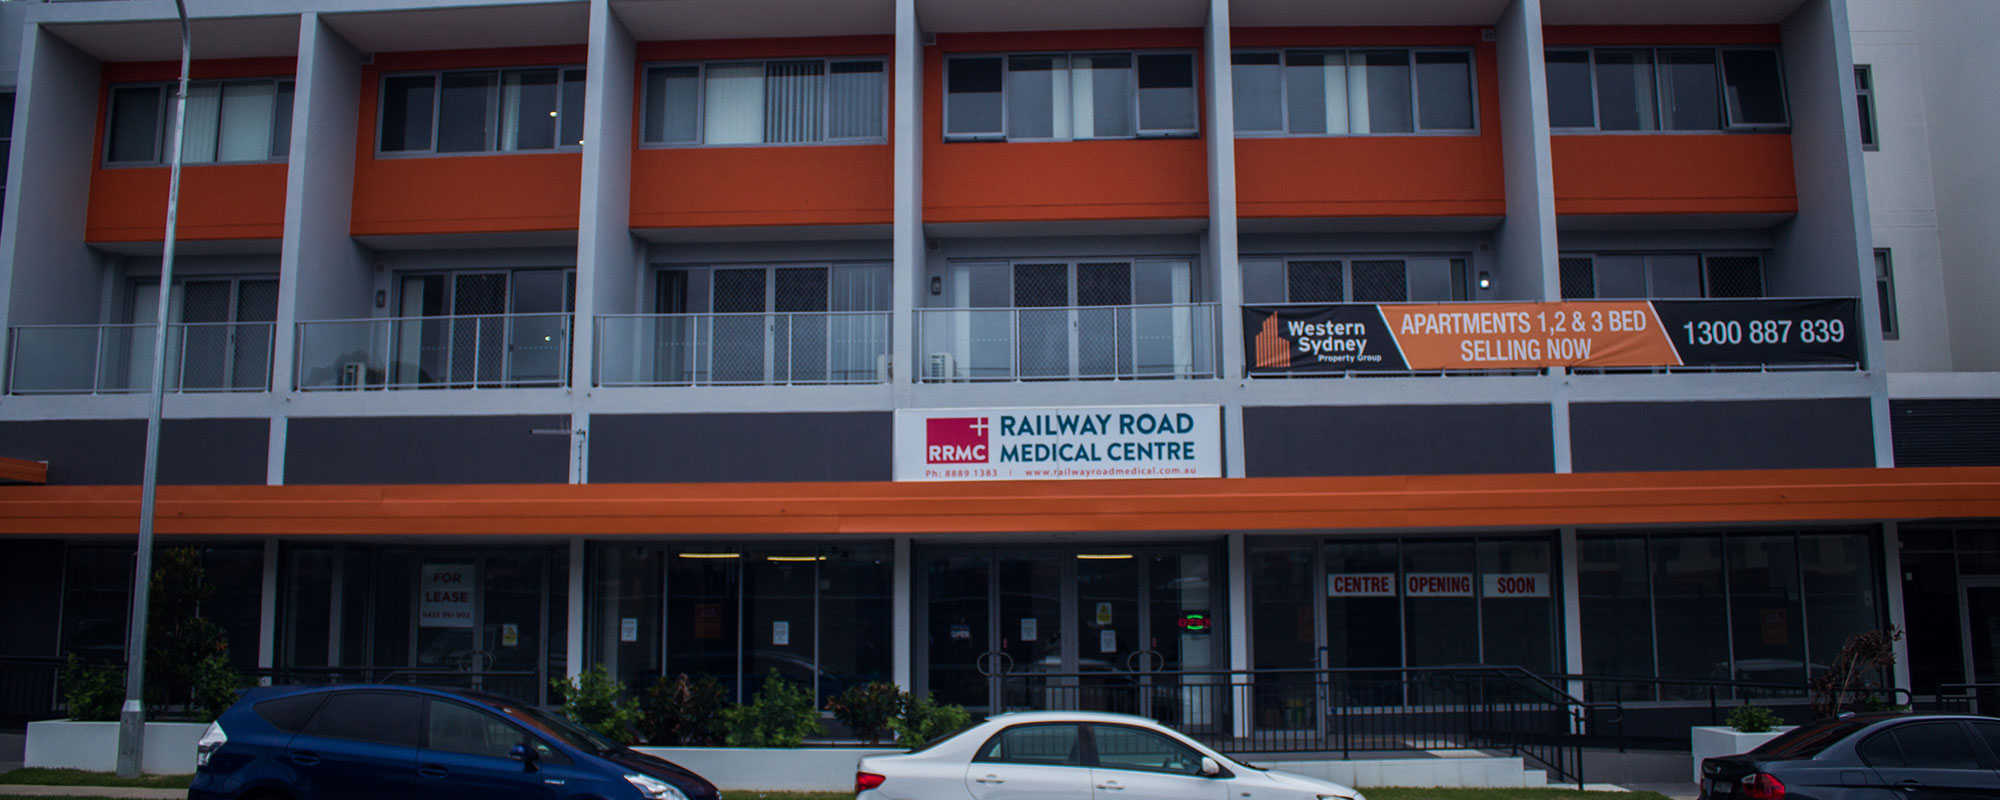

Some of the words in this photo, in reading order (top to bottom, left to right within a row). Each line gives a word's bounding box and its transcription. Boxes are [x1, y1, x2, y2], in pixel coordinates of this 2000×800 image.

[1287, 320, 1365, 337] Western
[1401, 312, 1531, 335] APARTMENTS
[1537, 311, 1566, 334] 1,2
[1571, 311, 1587, 332] &
[1591, 311, 1603, 332] 3
[1609, 310, 1647, 332] BED
[1683, 320, 1742, 345] 1300
[1749, 319, 1793, 344] 887
[1800, 318, 1845, 343] 839
[1298, 336, 1367, 356] Sydney
[1460, 339, 1541, 361] SELLING
[1547, 338, 1592, 360] NOW
[1318, 353, 1355, 364] Property
[1357, 353, 1382, 364] Group
[1000, 414, 1112, 436] RAILWAY
[1119, 413, 1194, 435] ROAD
[928, 444, 986, 461] RRMC
[1000, 443, 1101, 462] MEDICAL
[1107, 442, 1195, 461] CENTRE
[925, 469, 942, 478] Ph:
[944, 469, 970, 478] 8889
[973, 468, 998, 478] 1383
[1024, 467, 1197, 477] www.railwayroadmedical.com.au
[433, 572, 462, 583] FOR
[1334, 576, 1389, 593] CENTRE
[1409, 576, 1470, 593] OPENING
[1497, 577, 1535, 593] SOON
[425, 591, 469, 602] LEASE
